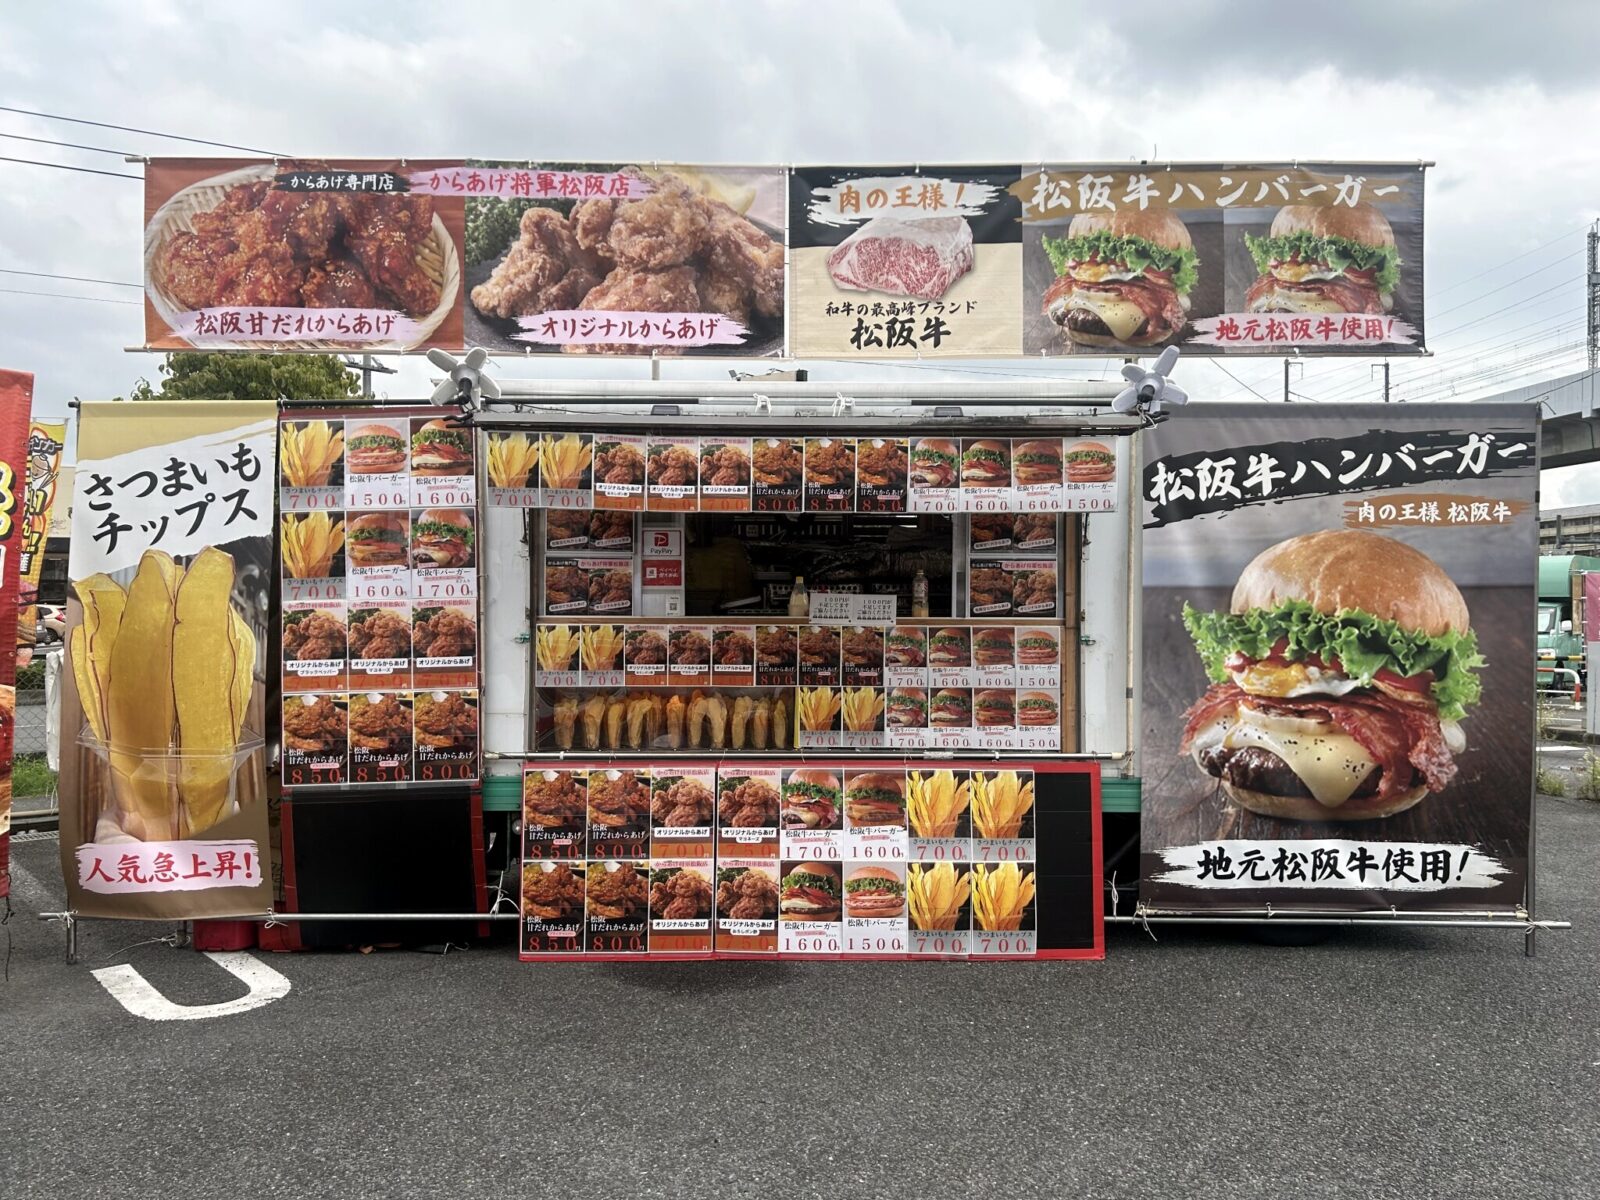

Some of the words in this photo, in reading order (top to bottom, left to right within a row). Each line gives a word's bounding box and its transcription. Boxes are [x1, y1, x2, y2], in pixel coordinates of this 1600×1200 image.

[290, 173, 394, 191] からあげ専門店
[429, 169, 631, 196] からあげ将軍松阪店
[1031, 174, 1401, 211] 松阪牛ハンバーガー
[838, 184, 967, 211] 肉の王様!
[826, 301, 976, 316] 和牛の最高峰ブランド
[195, 311, 400, 337] 松阪甘だれからあげ
[541, 316, 720, 339] オリジナルからあげ
[851, 316, 951, 350] 松阪牛
[1216, 316, 1393, 340] 地元松阪牛使用!
[84, 443, 261, 511] さつまいも
[1151, 433, 1529, 505] 松阪牛ハンバーガー
[416, 477, 469, 485] 松阪牛バーガー
[92, 488, 258, 555] チップス
[1358, 502, 1441, 522] 肉の王様
[1447, 503, 1512, 522] 松阪牛
[417, 569, 470, 577] 松阪牛バーガー
[289, 755, 343, 764] 甘だれからあげ
[355, 754, 408, 762] 甘だれからあげ
[420, 752, 473, 761] 甘だれからあげ
[530, 831, 581, 839] 甘だれからあげ
[593, 831, 645, 839] 甘だれからあげ
[86, 850, 252, 884] 人気急上昇!
[1197, 846, 1470, 884] 地元松阪牛使用!
[528, 923, 579, 931] 甘だれからあげ
[591, 923, 643, 931] 甘だれからあげ
